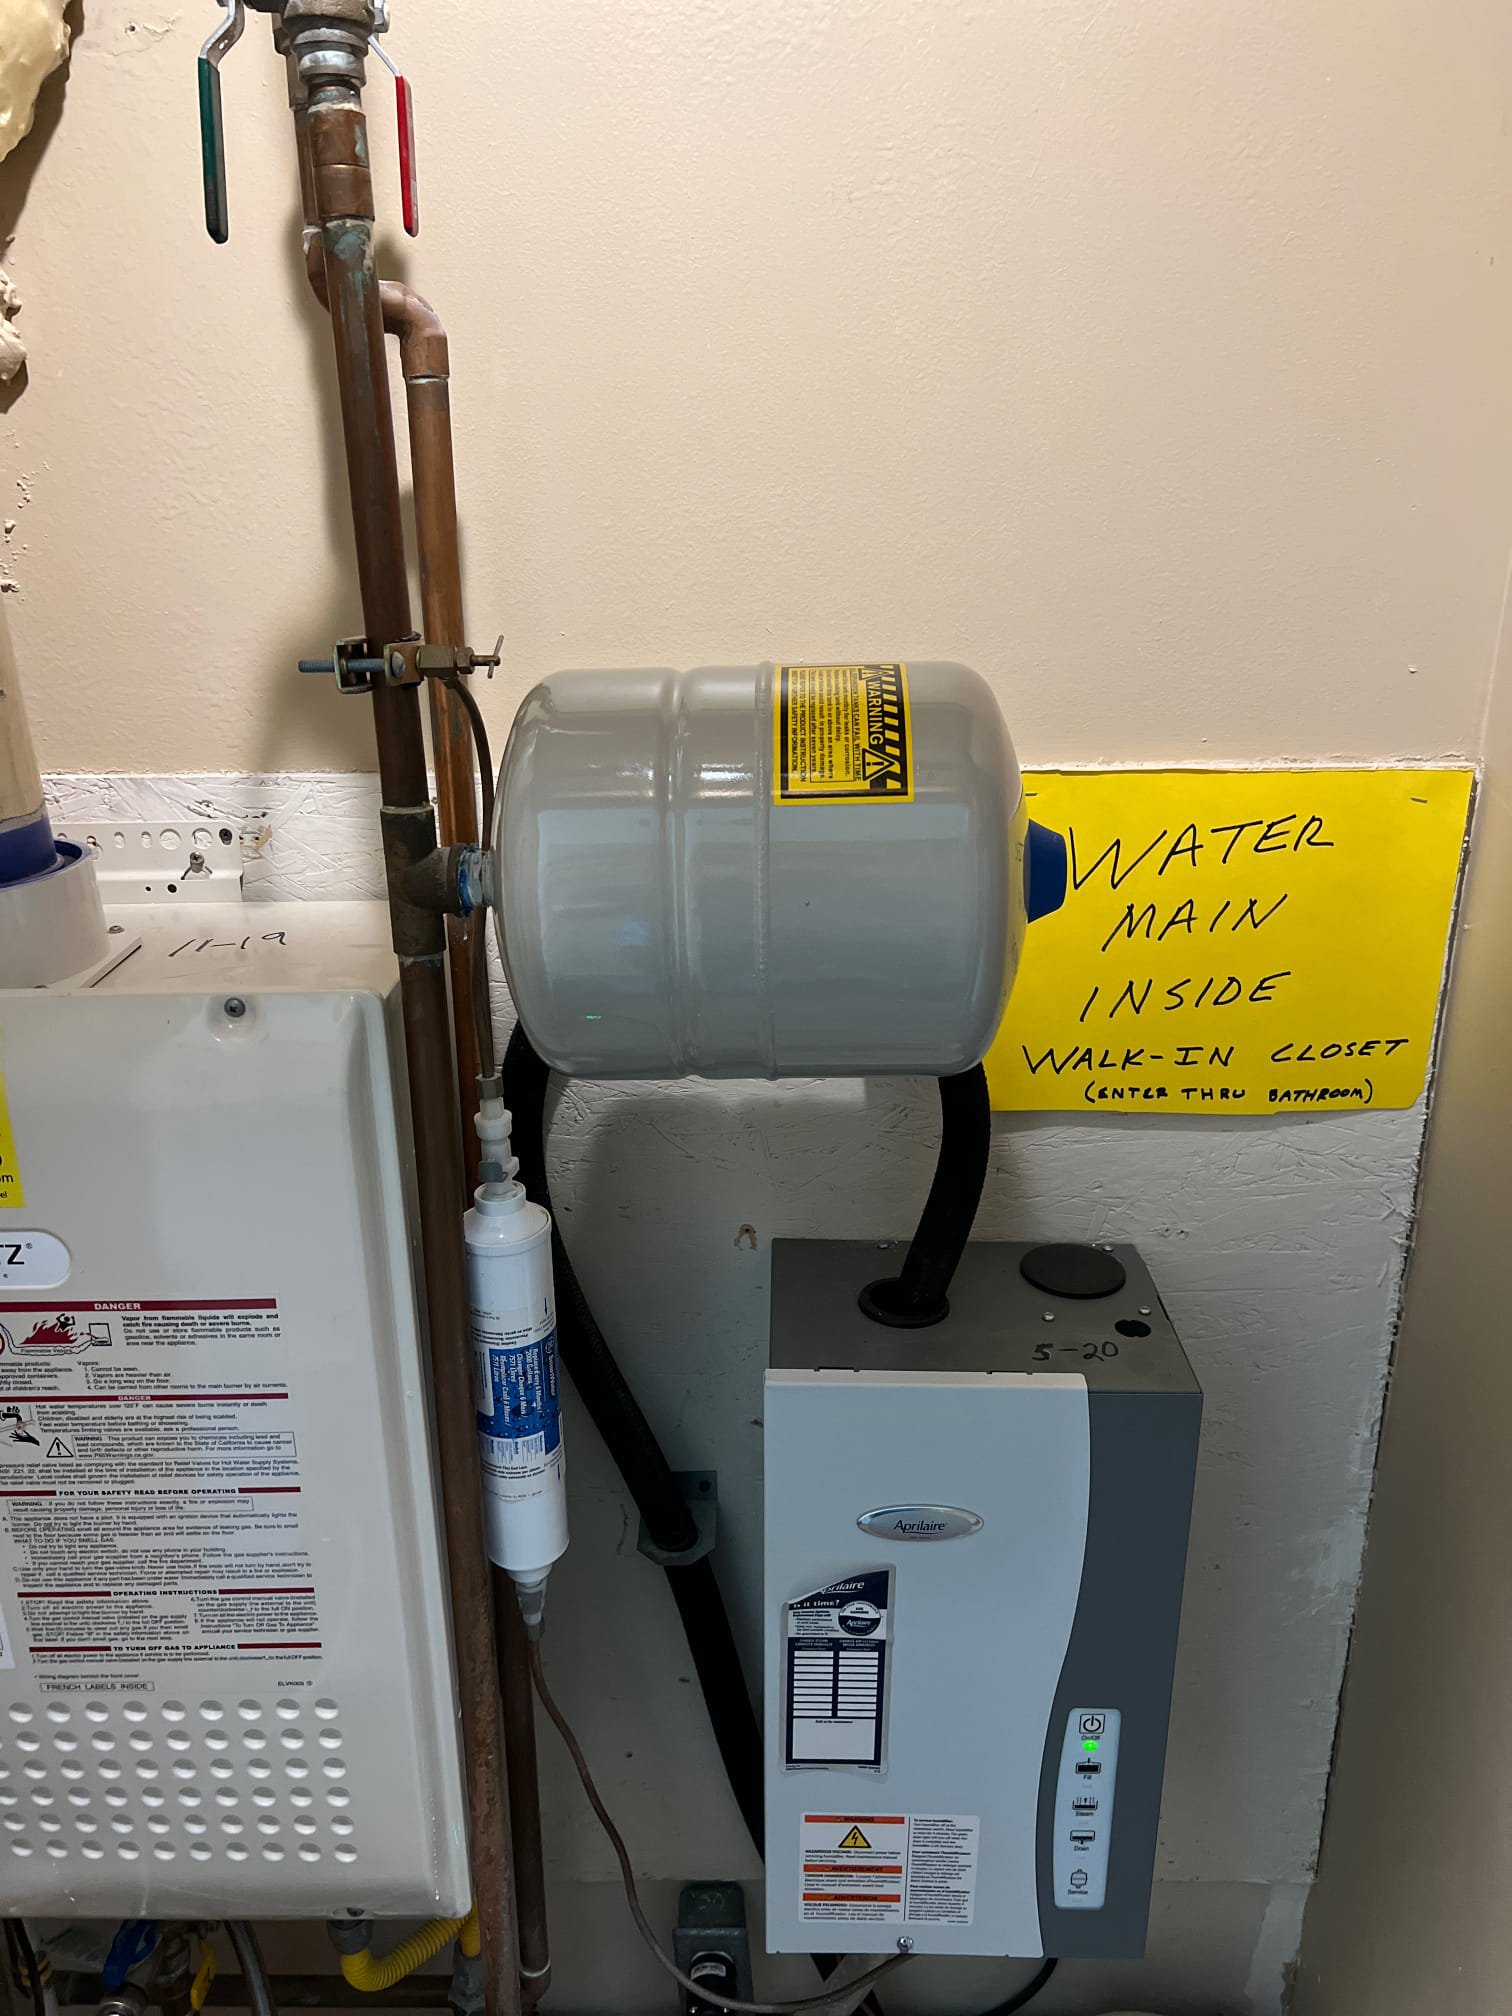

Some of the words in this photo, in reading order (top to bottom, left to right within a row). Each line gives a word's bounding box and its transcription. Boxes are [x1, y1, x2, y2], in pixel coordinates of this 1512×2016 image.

[868, 681, 883, 745] WARNING
[1069, 814, 1334, 890] WATER
[1101, 893, 1288, 952] MAIN
[1079, 971, 1291, 1022] INSIDE
[1022, 1045, 1234, 1075] WALK-IN
[1270, 1038, 1409, 1064] CLOSET
[1084, 1081, 1169, 1103] (ENTER
[1181, 1087, 1246, 1101] THRU
[1268, 1078, 1374, 1104] BATHROOM)
[94, 1303, 141, 1311] DANGER
[1031, 1341, 1119, 1363] 5-20
[893, 1519, 946, 1534] Aprilaire
[814, 1600, 840, 1608] time?
